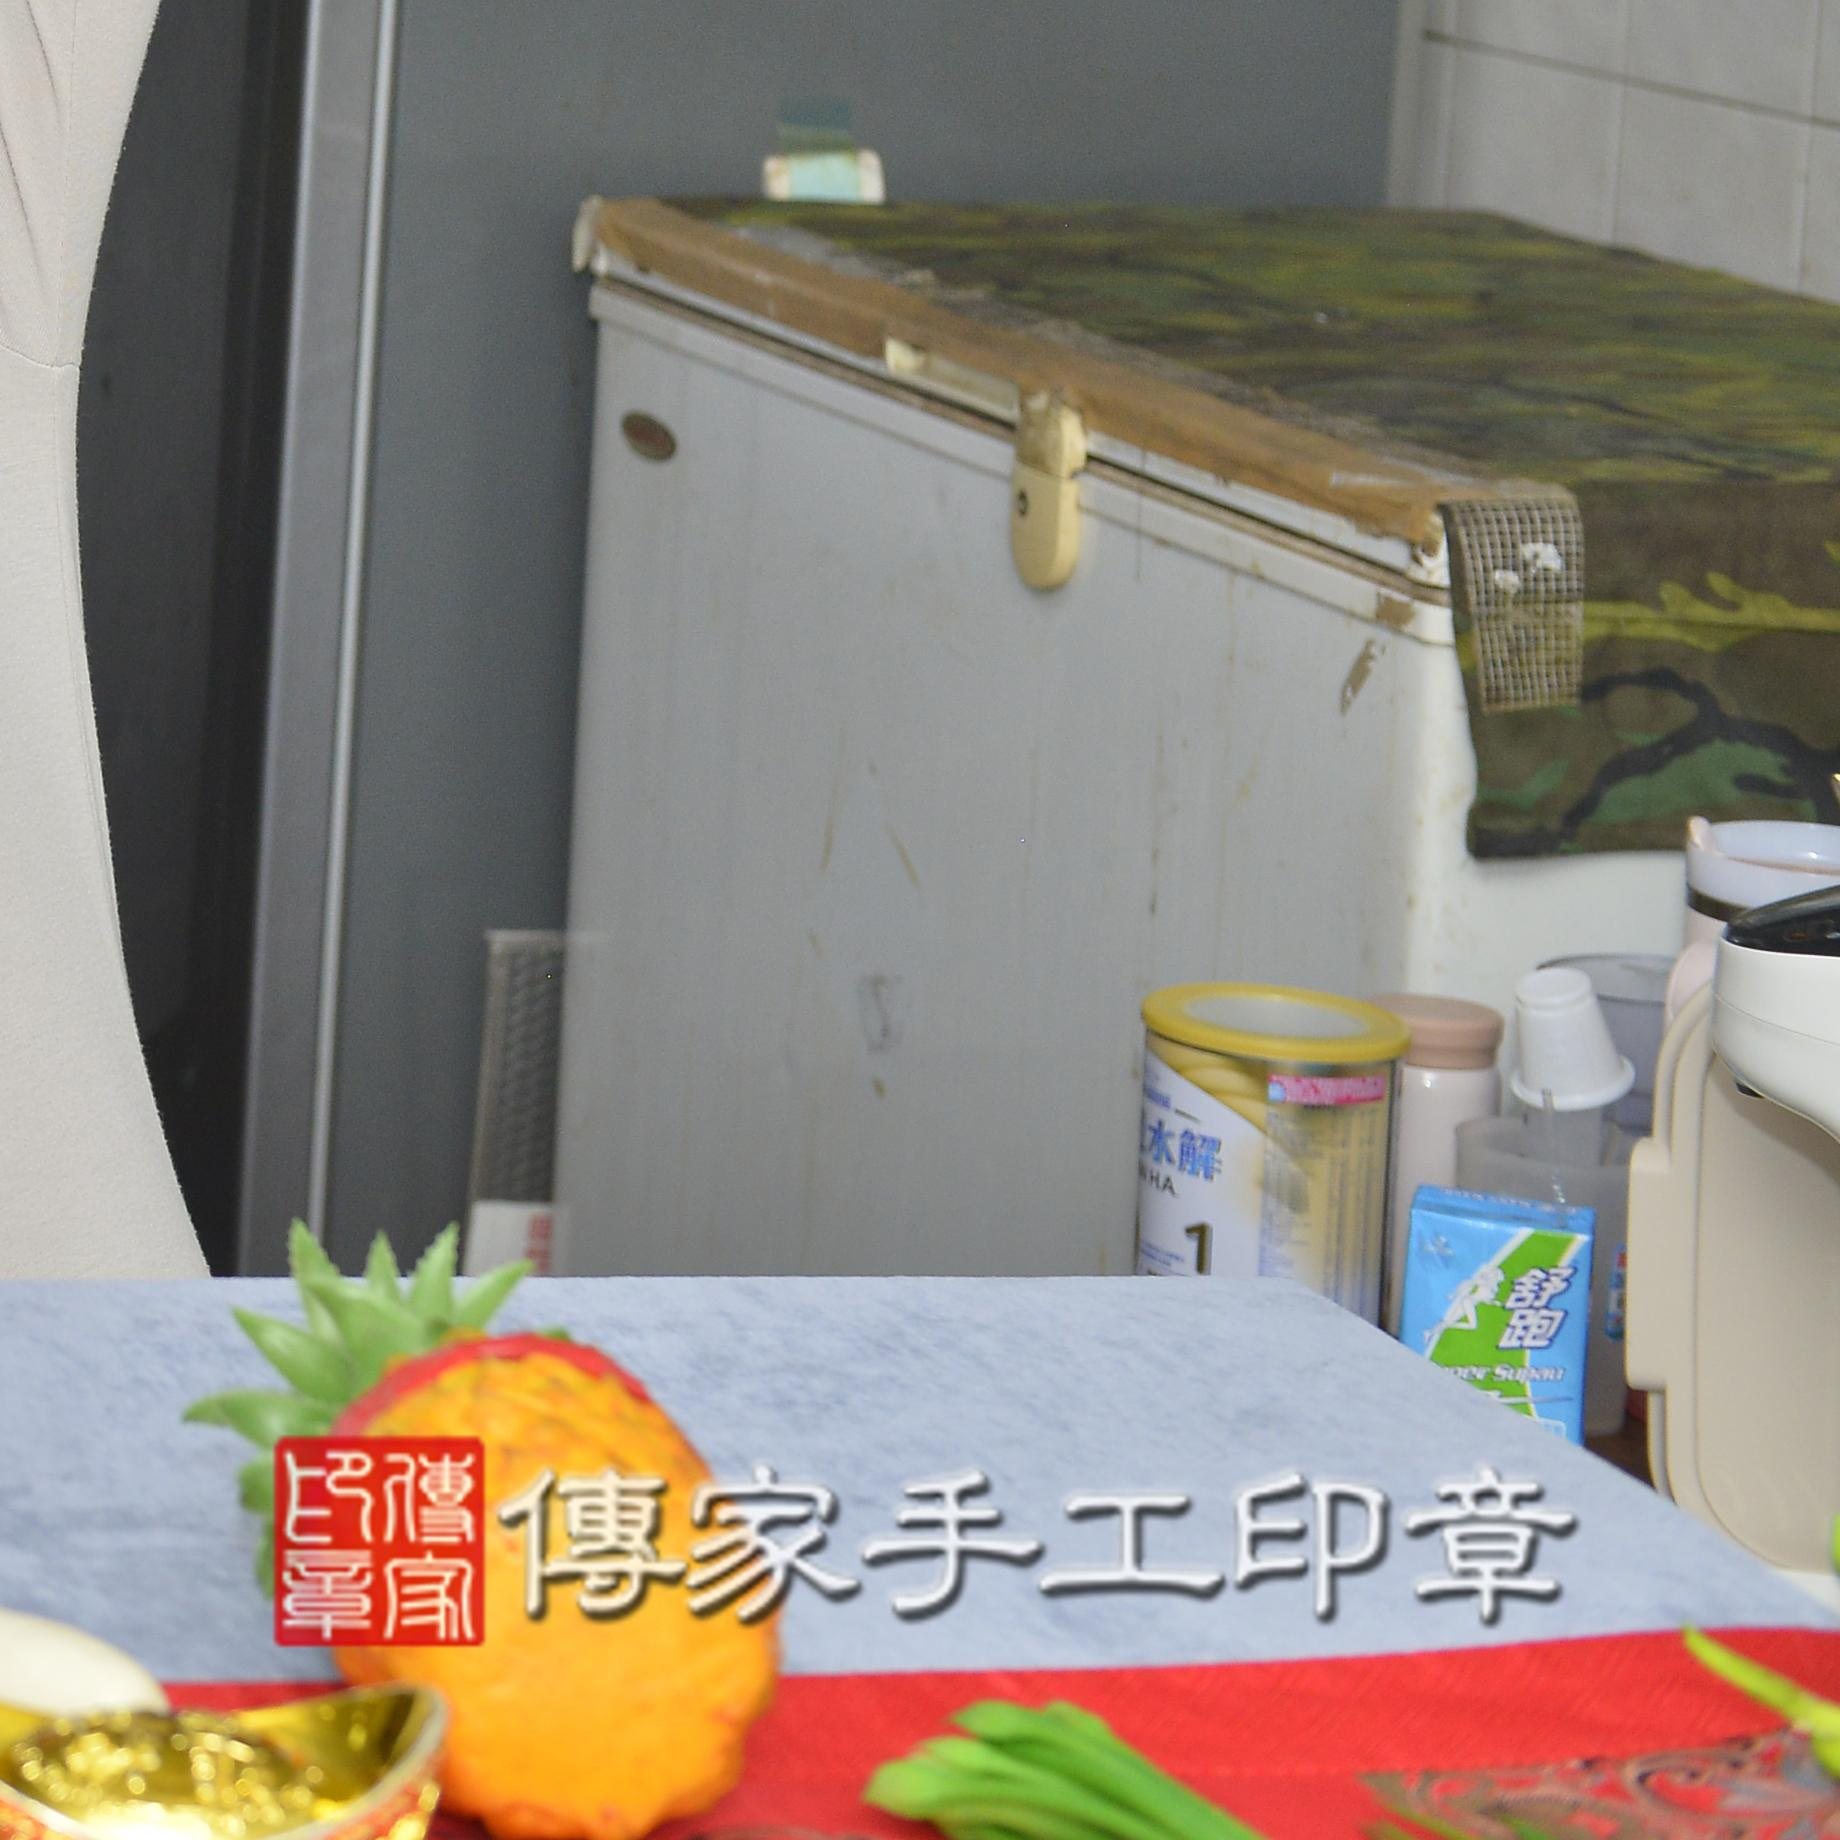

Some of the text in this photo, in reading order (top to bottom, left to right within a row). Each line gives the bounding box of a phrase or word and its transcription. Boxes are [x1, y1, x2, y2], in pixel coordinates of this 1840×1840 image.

[1140, 1117, 1224, 1182] 水解
[1184, 1221, 1214, 1275] 1
[1497, 1265, 1578, 1350] 舒跑
